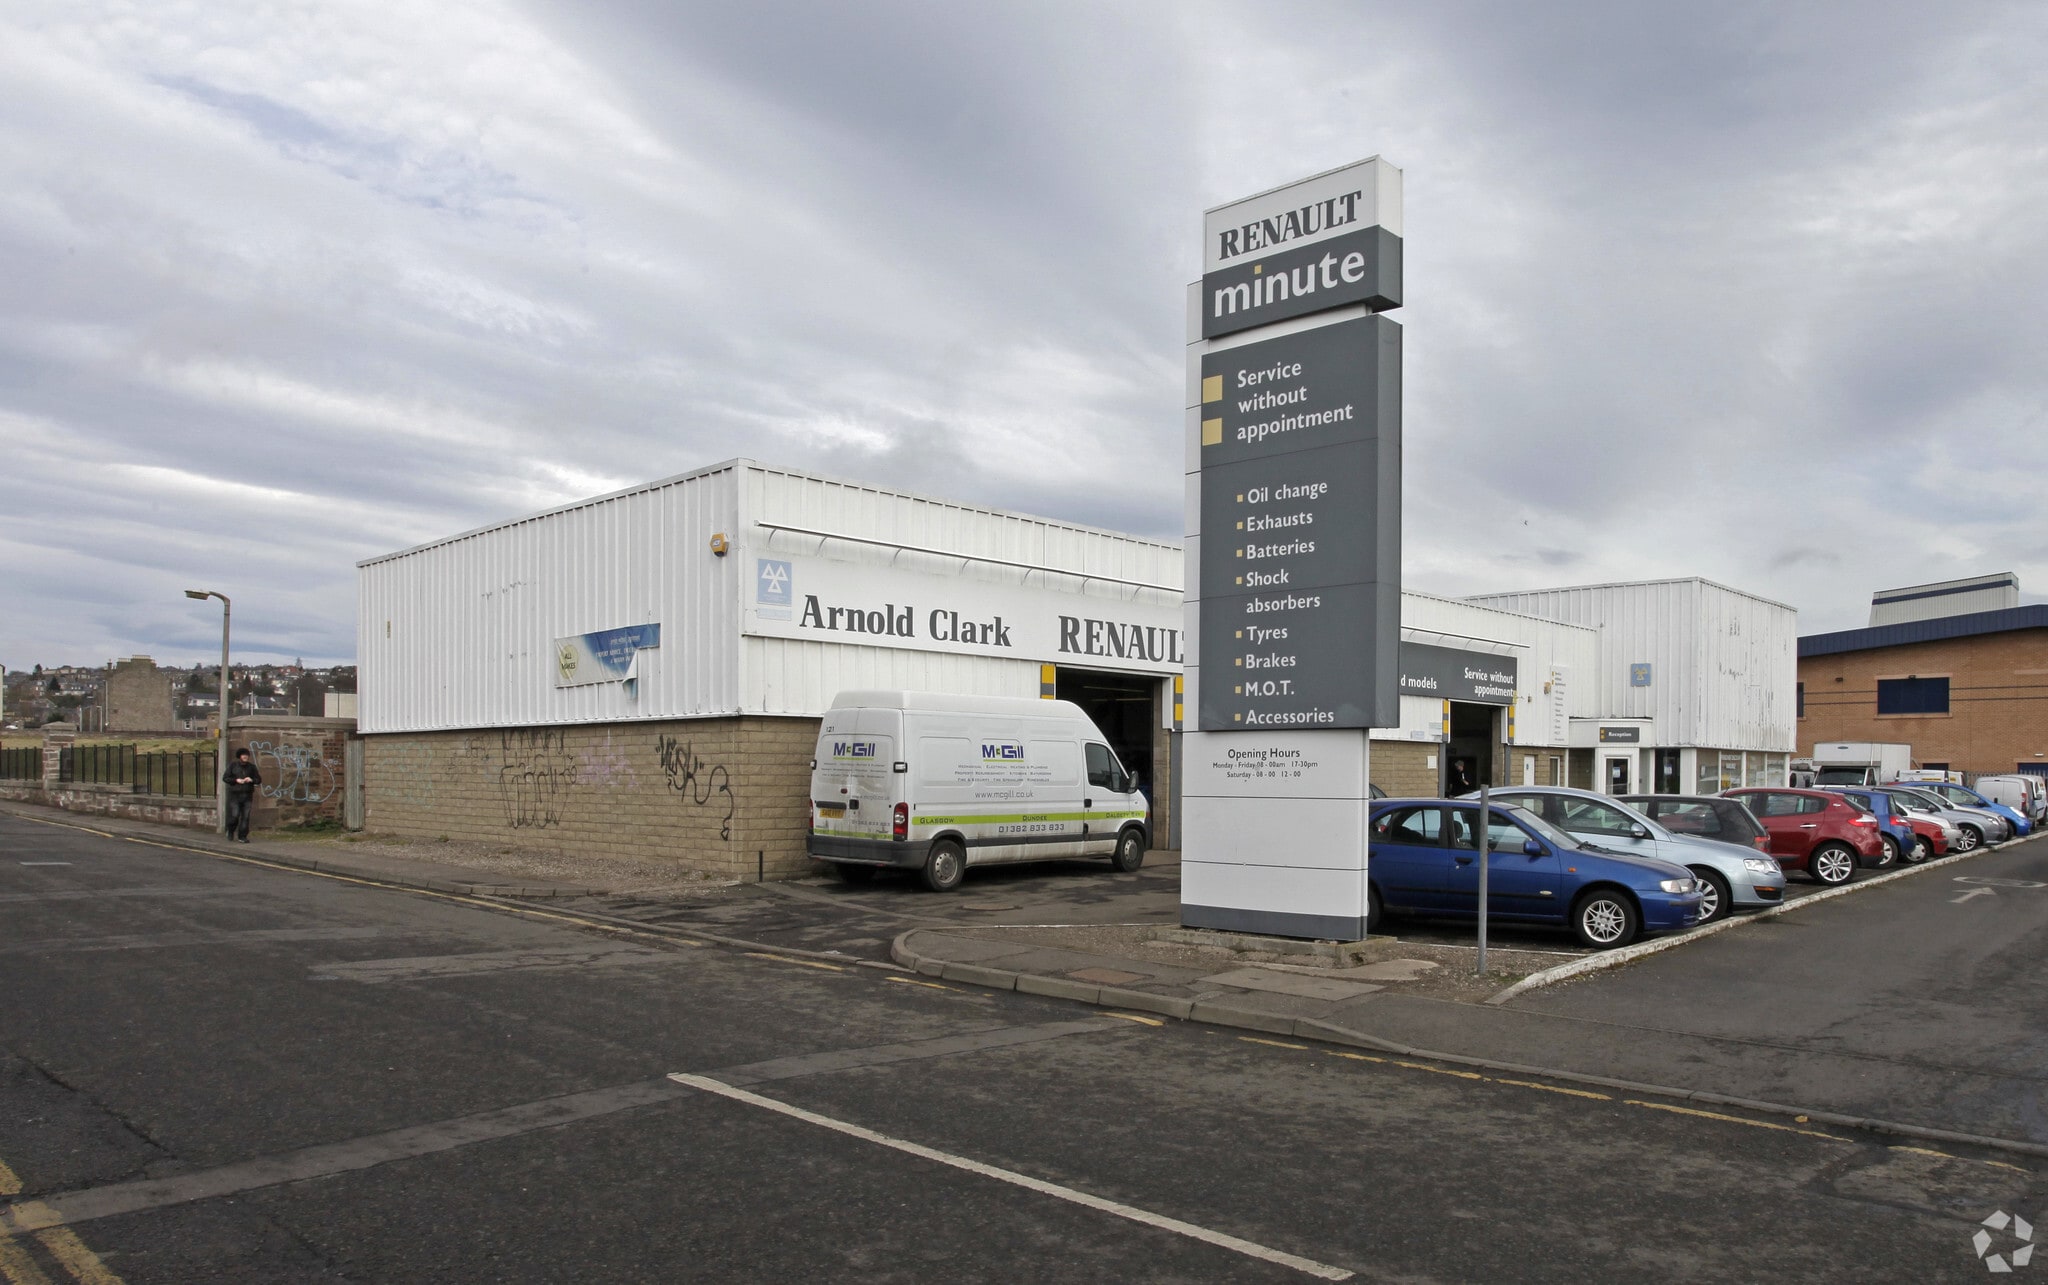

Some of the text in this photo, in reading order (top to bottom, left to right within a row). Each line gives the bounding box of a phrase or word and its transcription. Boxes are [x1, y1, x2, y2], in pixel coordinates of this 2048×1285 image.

[1219, 190, 1361, 260] RENAULT
[1214, 251, 1365, 318] minute
[1237, 362, 1302, 388] Service
[1238, 385, 1307, 413] without
[1237, 404, 1353, 443] appointment
[1247, 482, 1328, 504] Oil change
[1247, 511, 1313, 532] Exhausts
[1246, 539, 1315, 560] Batteries
[1246, 569, 1289, 587] Shock
[1246, 594, 1321, 614] absorbers
[800, 594, 1012, 647] Arnold Clark
[1058, 615, 1184, 663] RENAUL
[1246, 626, 1288, 645] Tyres
[1245, 653, 1296, 669] Brakes
[1408, 676, 1437, 689] models
[1464, 667, 1514, 684] Service without
[1245, 680, 1295, 697] M.O.T.
[1474, 684, 1514, 697] appointment
[1245, 708, 1335, 725] Accessories
[1228, 748, 1301, 761] Opening Hours
[1238, 761, 1255, 769] Friday
[1226, 771, 1251, 779] Saturday
[974, 790, 1034, 799] www.mcgill.co.uk
[998, 823, 1065, 833] 01382 833 833
